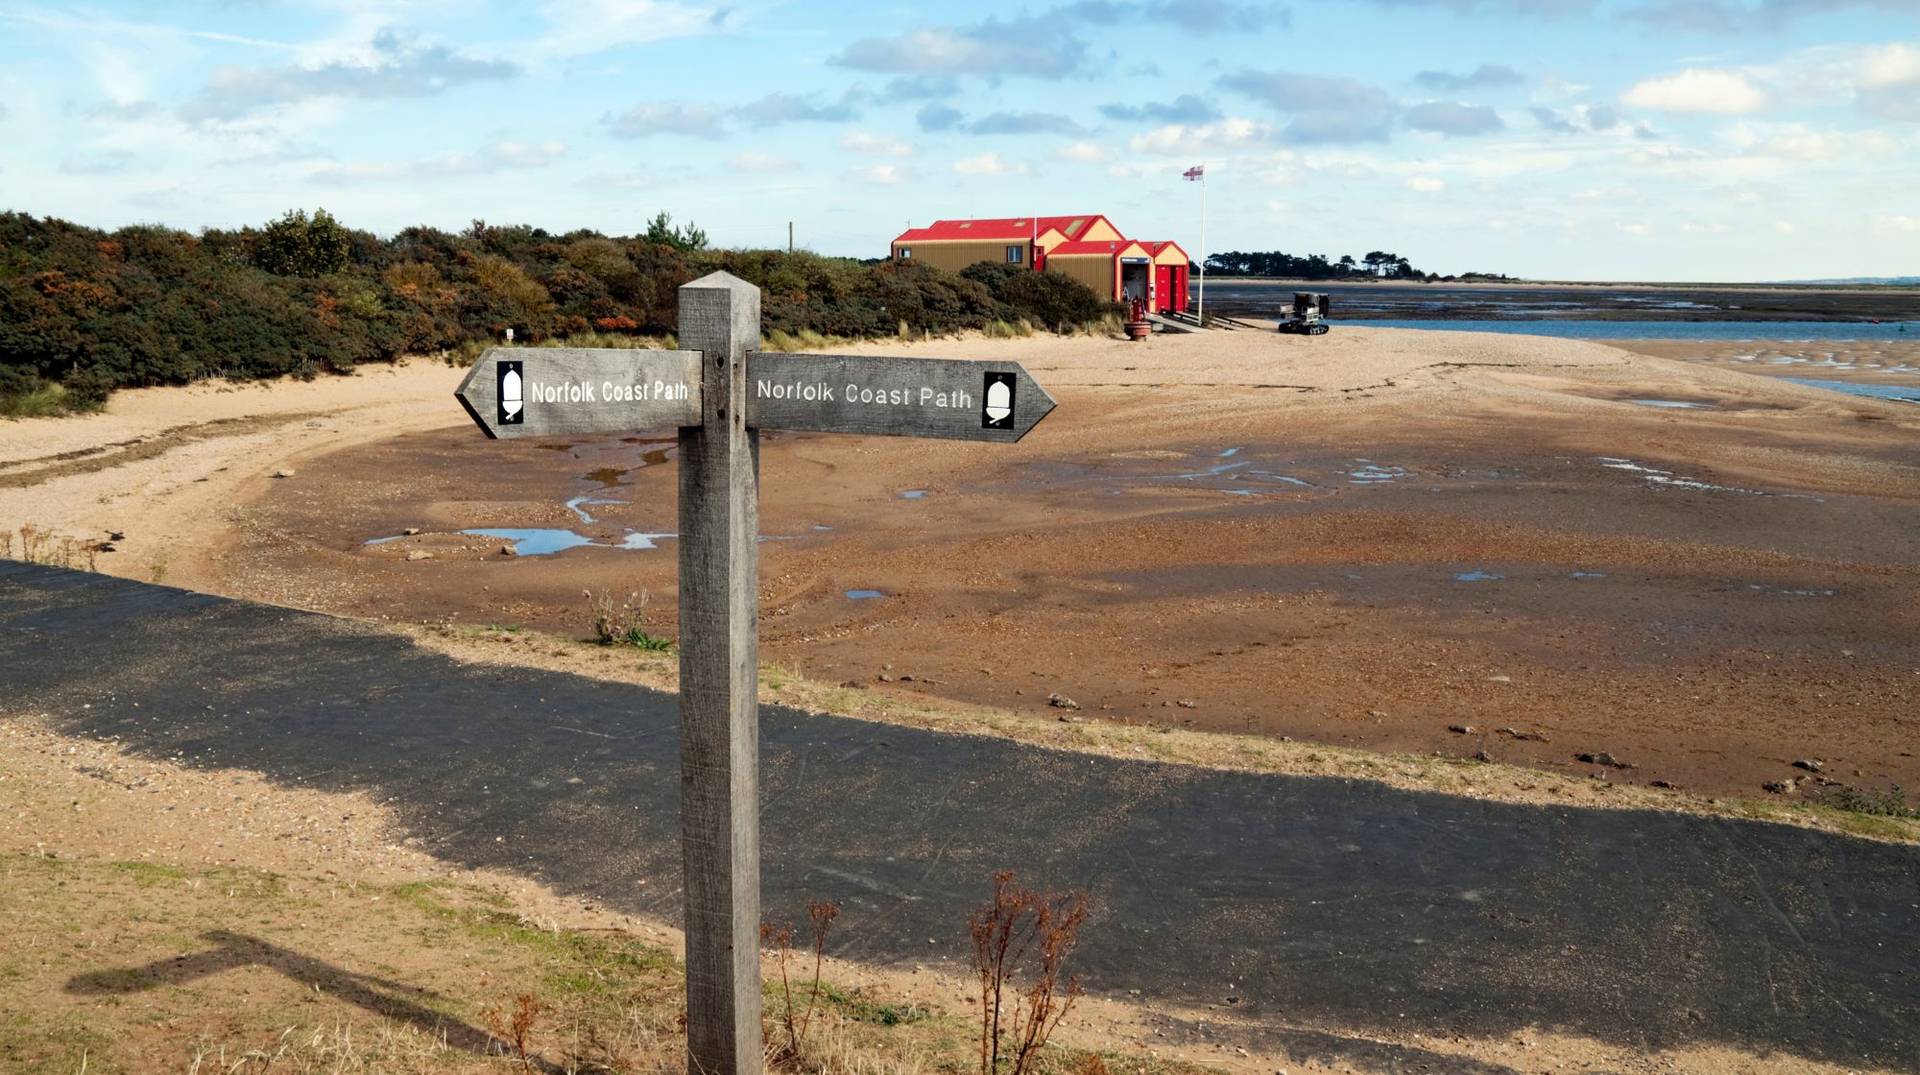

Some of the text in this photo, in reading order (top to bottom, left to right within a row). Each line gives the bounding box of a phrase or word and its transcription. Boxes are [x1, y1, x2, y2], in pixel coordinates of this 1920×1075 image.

[532, 380, 688, 403] Norfolk Coast Path
[757, 379, 971, 409] Norfolk Coast Path
